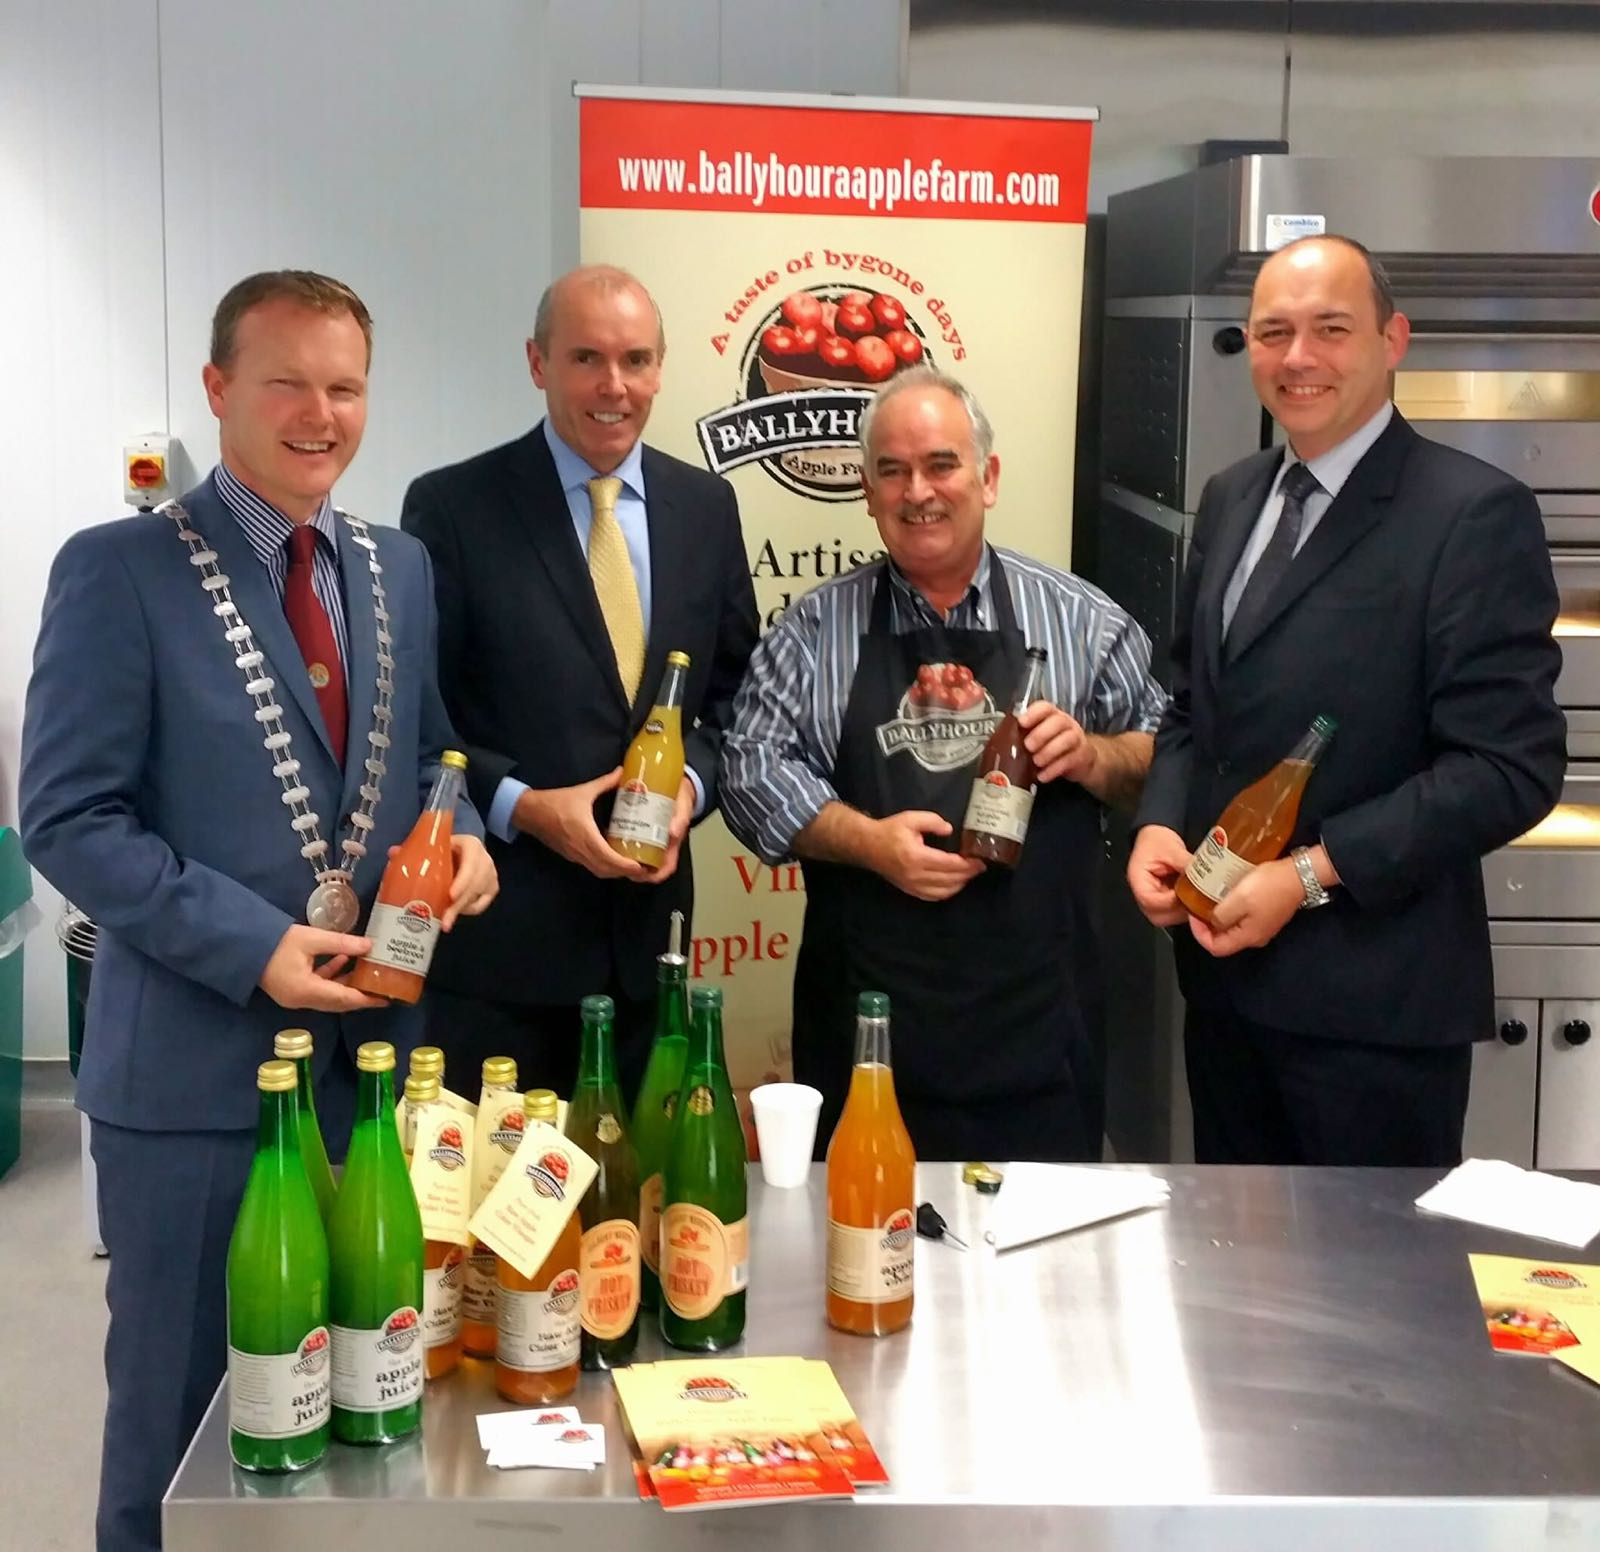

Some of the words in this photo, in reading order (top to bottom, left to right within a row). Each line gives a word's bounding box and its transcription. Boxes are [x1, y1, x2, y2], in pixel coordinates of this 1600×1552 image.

[618, 150, 1060, 212] www.ballyhouraapplefarm.com
[710, 331, 730, 356] A
[724, 269, 780, 325] taste
[786, 251, 814, 274] of
[823, 248, 926, 296] bygone
[926, 297, 967, 362] days
[716, 406, 860, 452] BALLYH
[785, 455, 837, 476] Apple
[886, 719, 996, 745] BALLYHOUR
[689, 919, 789, 978] pple
[375, 1358, 421, 1384] apple
[377, 1377, 420, 1402] juice
